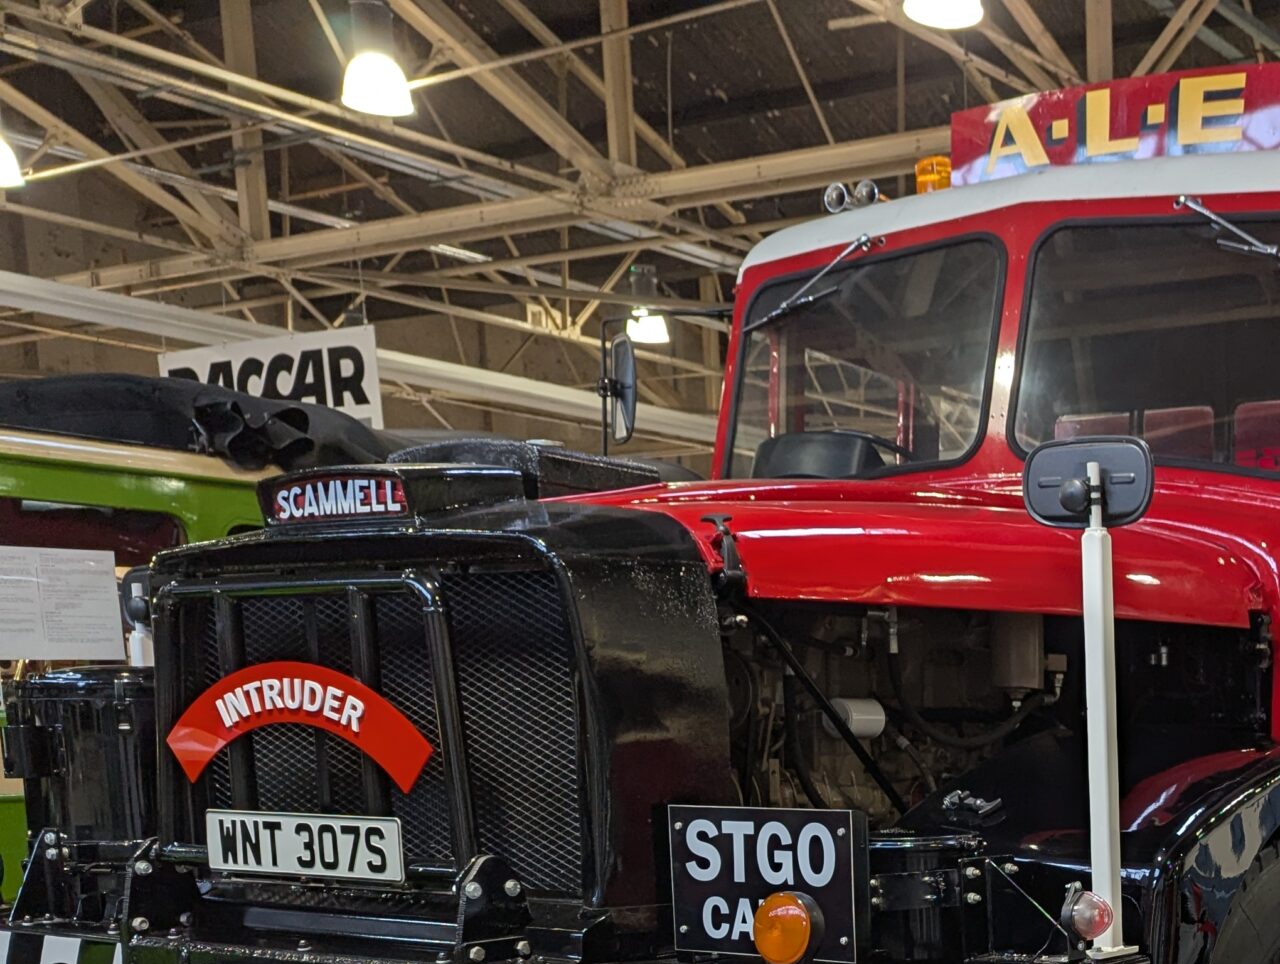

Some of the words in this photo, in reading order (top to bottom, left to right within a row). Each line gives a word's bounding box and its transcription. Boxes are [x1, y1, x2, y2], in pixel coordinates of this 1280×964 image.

[167, 345, 371, 407] ACCAR
[277, 479, 402, 521] SCAMMELL
[214, 677, 366, 734] INTRUDER
[217, 818, 282, 868] WNT
[294, 823, 389, 876] 307S
[685, 818, 837, 888] STGO
[702, 895, 766, 942] CA
